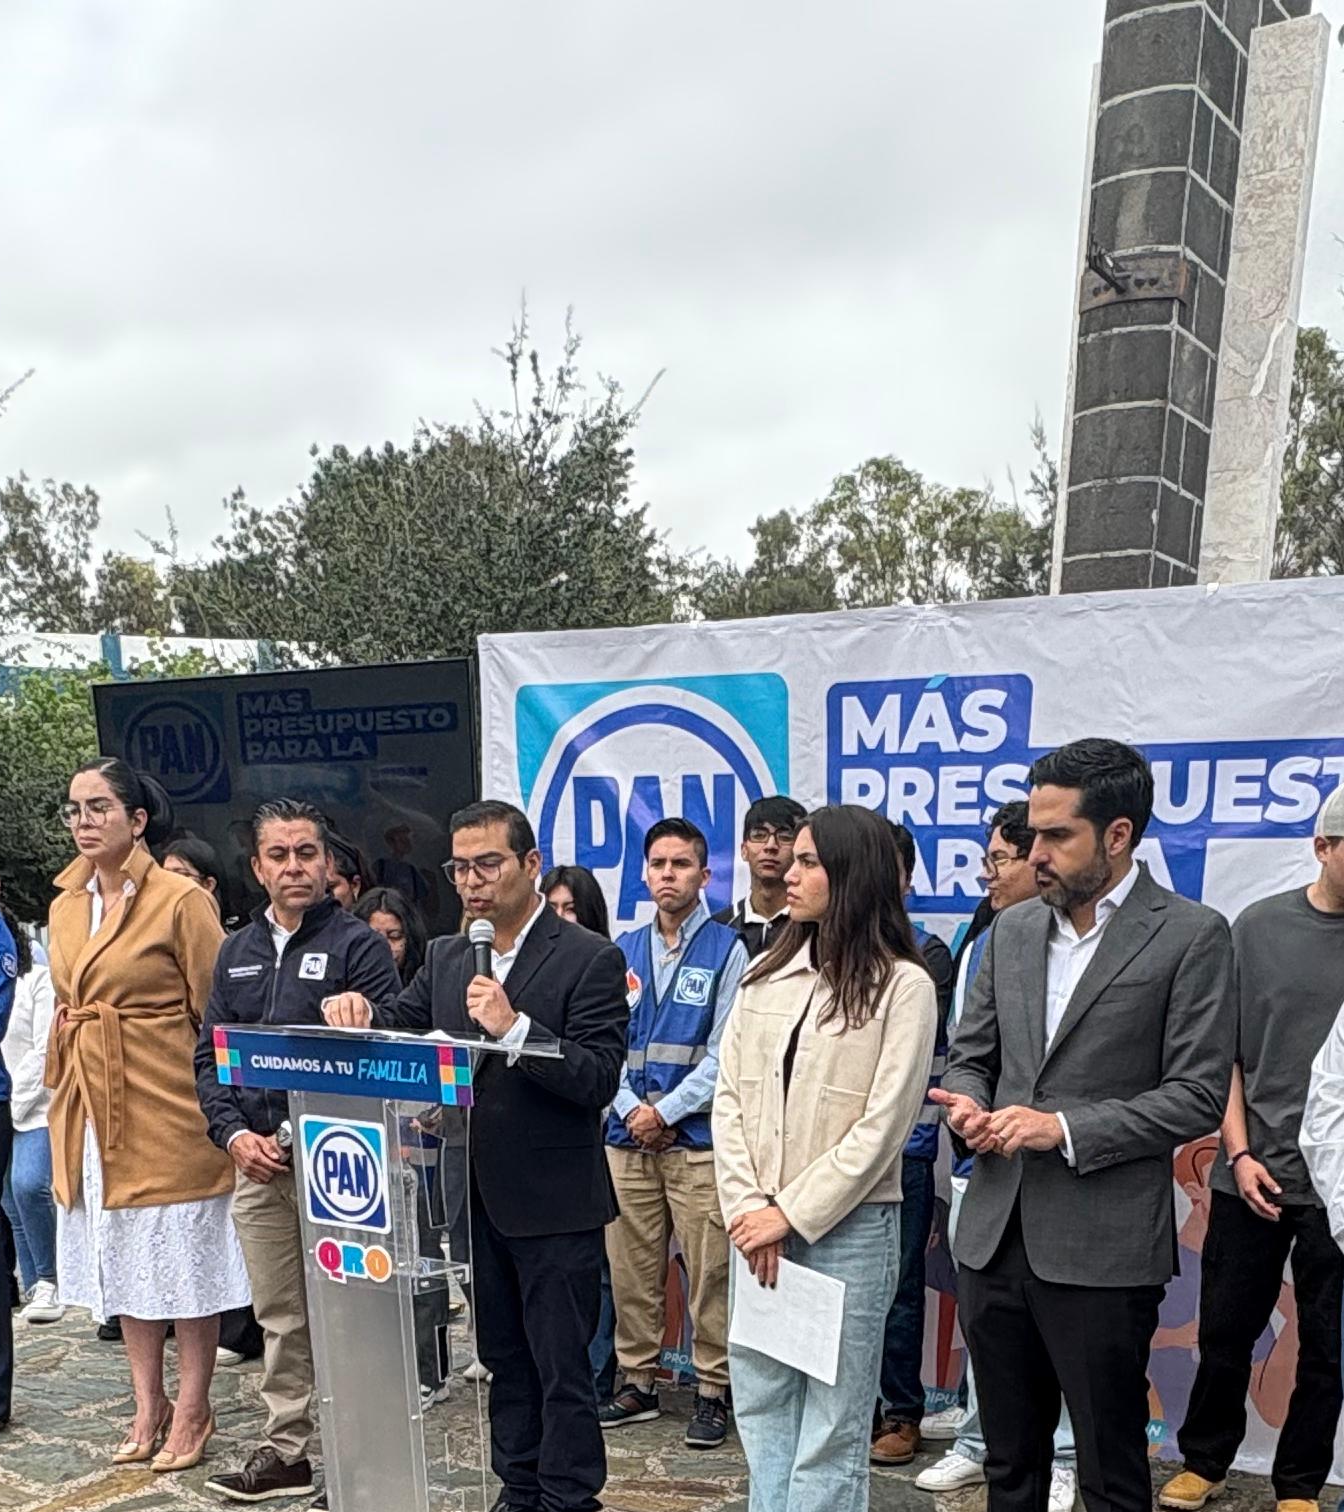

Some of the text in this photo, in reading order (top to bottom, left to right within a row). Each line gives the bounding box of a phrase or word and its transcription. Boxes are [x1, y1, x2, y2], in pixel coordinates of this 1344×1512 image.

[244, 708, 452, 738] PRESUPUESTO
[841, 674, 1008, 756] MÁS
[139, 722, 207, 775] PAN
[246, 735, 369, 761] PARA LA
[572, 773, 735, 921] PAN
[685, 977, 707, 995] PAN
[251, 1055, 428, 1085] CUIDAMOS A TU FAMILIA
[322, 1149, 371, 1200] PAN
[316, 1239, 391, 1282] QRO
